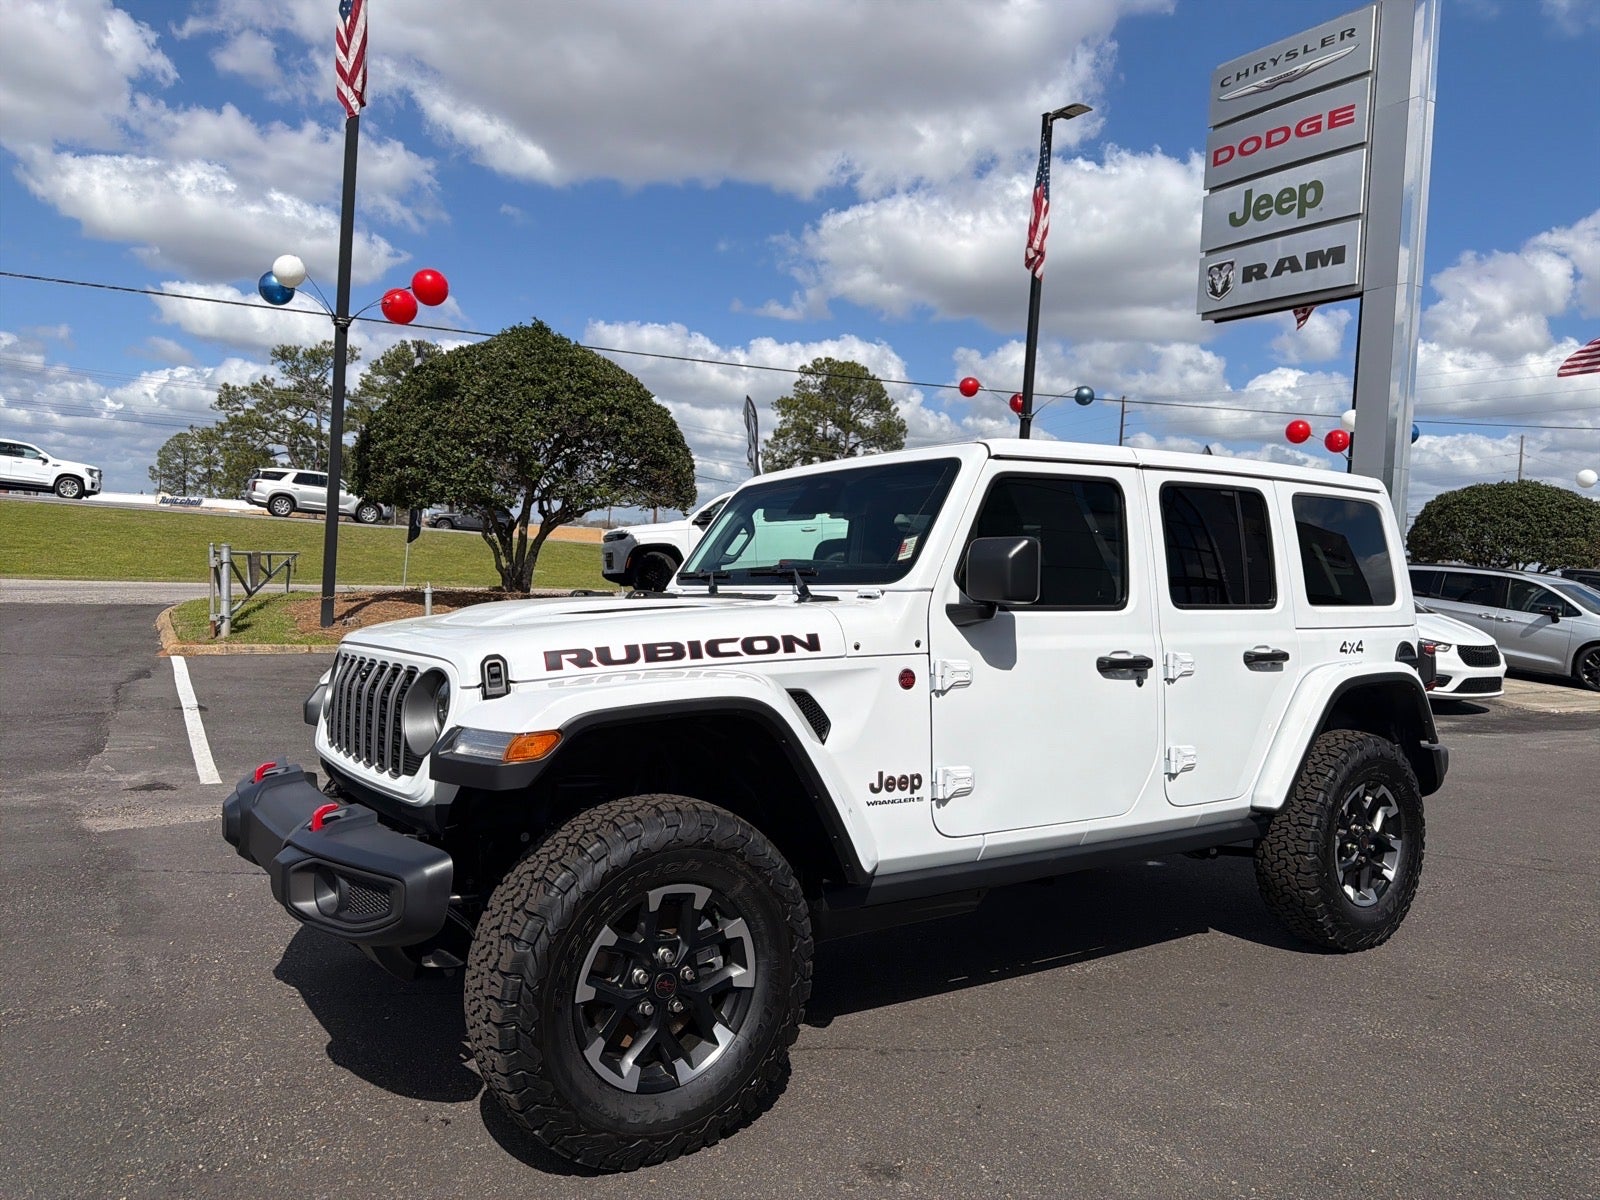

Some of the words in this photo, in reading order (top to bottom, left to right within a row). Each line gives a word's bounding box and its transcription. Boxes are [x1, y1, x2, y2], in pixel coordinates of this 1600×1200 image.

[1220, 27, 1356, 88] CHRYSLER
[1212, 103, 1356, 168] DODGE
[1228, 179, 1324, 228] Jeep
[1241, 245, 1346, 284] RAM
[543, 632, 821, 671] RUBICON
[865, 796, 916, 807] WRANGLER
[868, 770, 923, 795] Jeep
